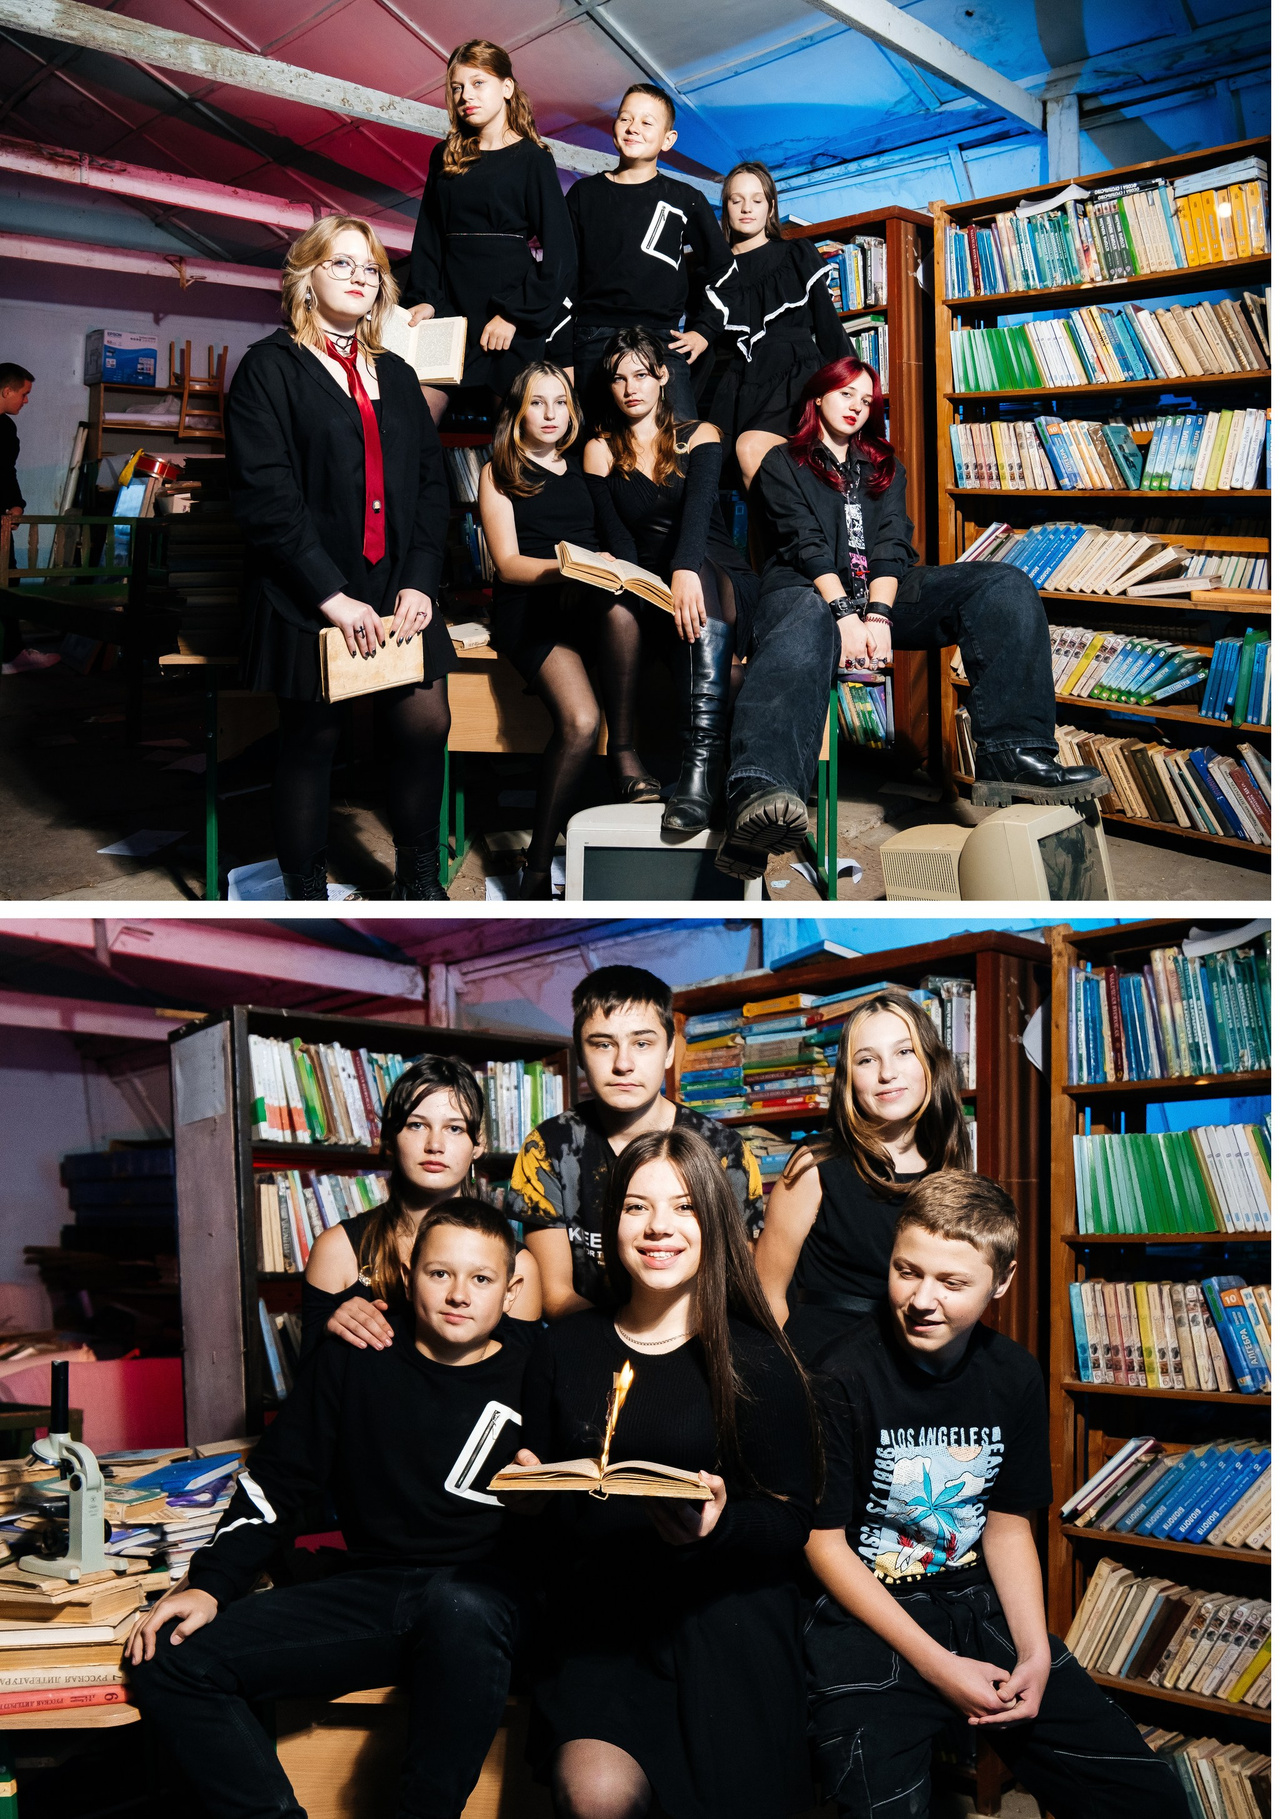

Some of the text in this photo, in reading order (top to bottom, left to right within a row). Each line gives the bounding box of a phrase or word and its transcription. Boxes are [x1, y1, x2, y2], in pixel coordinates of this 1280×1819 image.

[1185, 417, 1191, 425] 9
[1060, 448, 1072, 471] АЛГЕБРА
[1135, 644, 1141, 652] 9
[1140, 662, 1155, 680] ГЕОМЕТРІЯ
[1151, 667, 1169, 683] ГЕОМЕТРІЯ
[1169, 679, 1190, 693] ГЕОМЕТРІЯ
[1224, 1294, 1237, 1305] 10
[1240, 1328, 1259, 1365] АЛГЕБРА
[891, 1426, 990, 1448] LOS ANGELES
[1125, 1503, 1147, 1525] БІОЛОГІЯ
[1145, 1504, 1167, 1528] БІОЛОГІЯ
[1162, 1506, 1185, 1531] БІОЛОГІЯ
[1178, 1508, 1202, 1533] БІОЛОГІЯ
[1196, 1510, 1220, 1535] БІОЛОГІЯ
[64, 1673, 108, 1682] РУССКАЯ
[34, 1698, 64, 1709] РУССКАЯ
